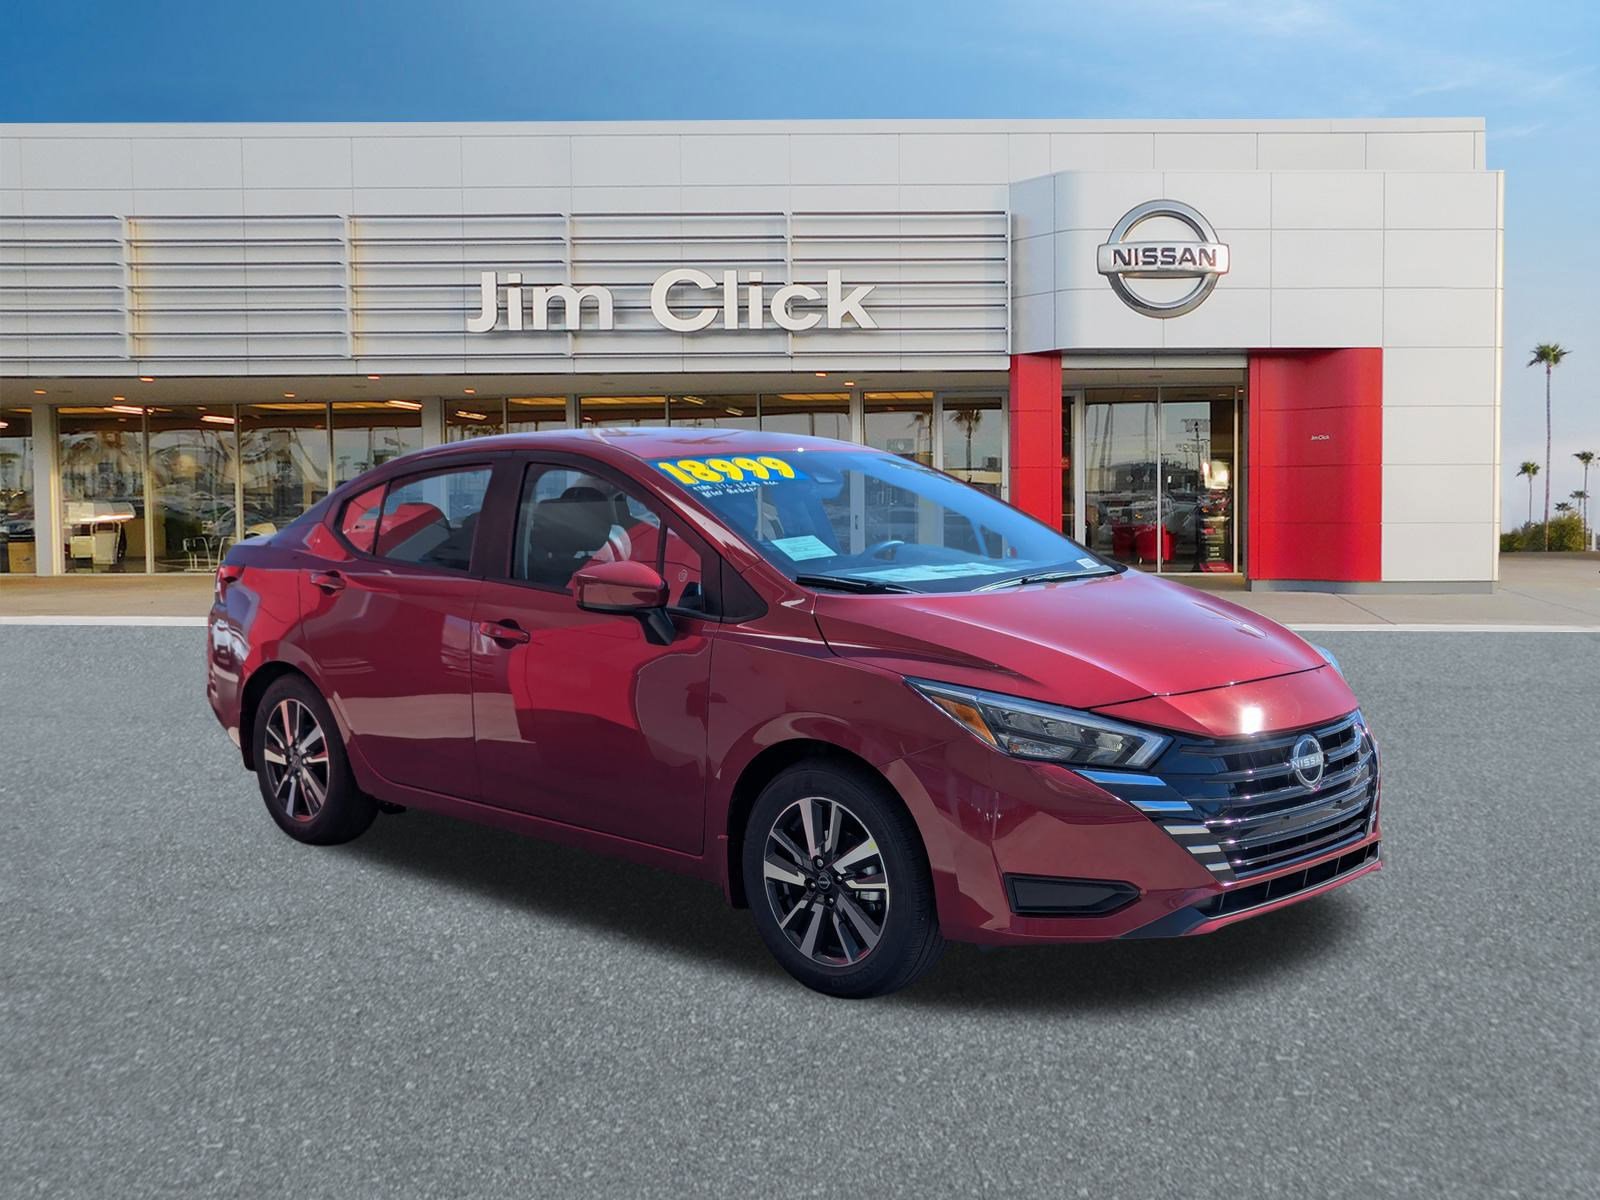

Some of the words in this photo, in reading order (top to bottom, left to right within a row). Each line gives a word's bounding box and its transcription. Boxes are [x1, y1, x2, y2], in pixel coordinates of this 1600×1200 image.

[1112, 247, 1217, 266] NISSAN
[467, 271, 614, 333] Jim
[650, 269, 879, 332] Click
[658, 456, 795, 484] 18999
